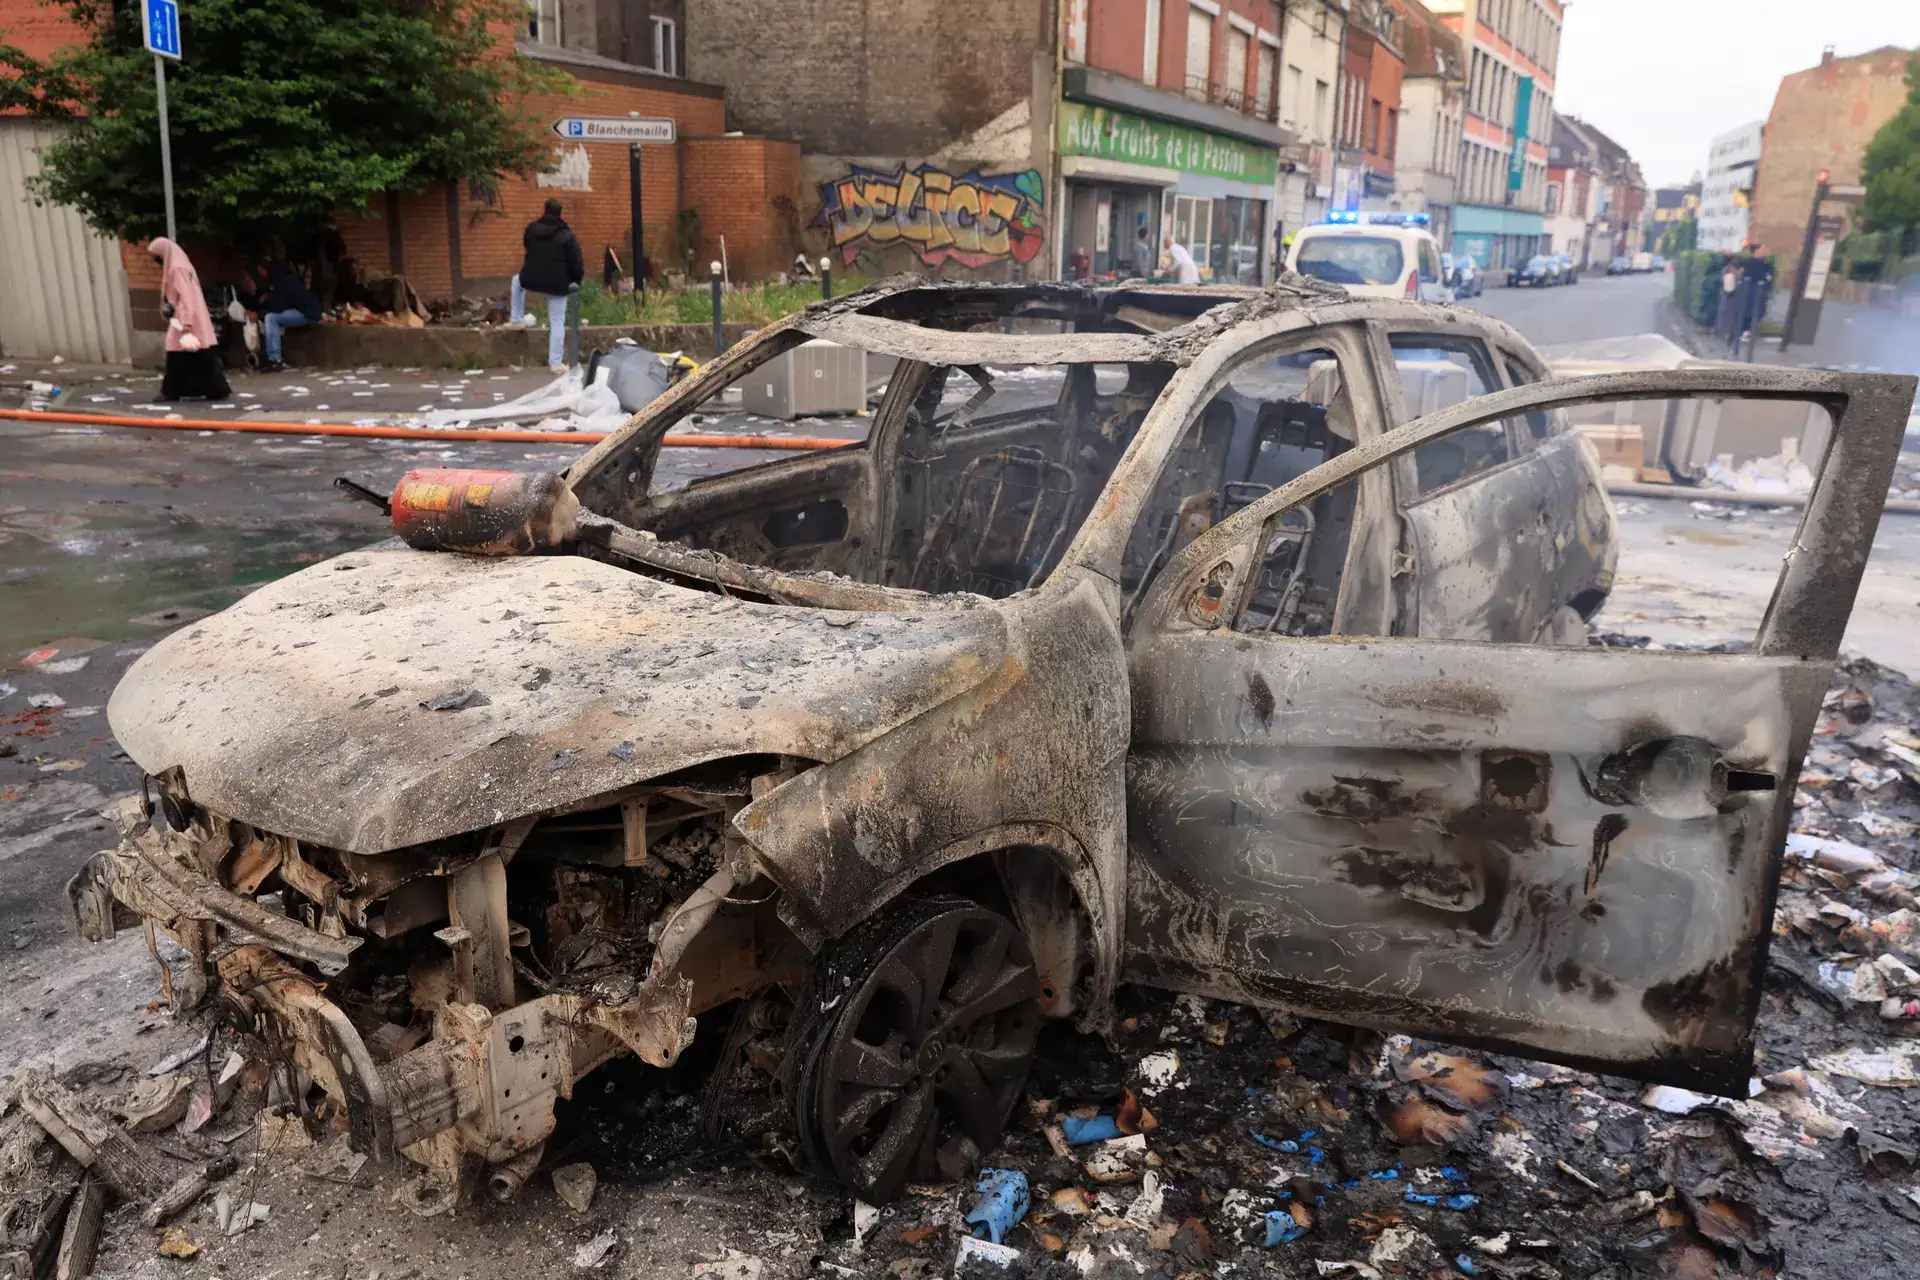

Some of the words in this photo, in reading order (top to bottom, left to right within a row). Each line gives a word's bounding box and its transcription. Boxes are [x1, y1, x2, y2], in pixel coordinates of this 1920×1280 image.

[570, 122, 582, 135] P
[588, 123, 669, 137] Blanchemaille
[1067, 110, 1102, 154] Aux
[1110, 113, 1159, 160] Fruits
[1166, 129, 1182, 167] de
[1187, 132, 1200, 169] la
[1203, 134, 1245, 176] Passion
